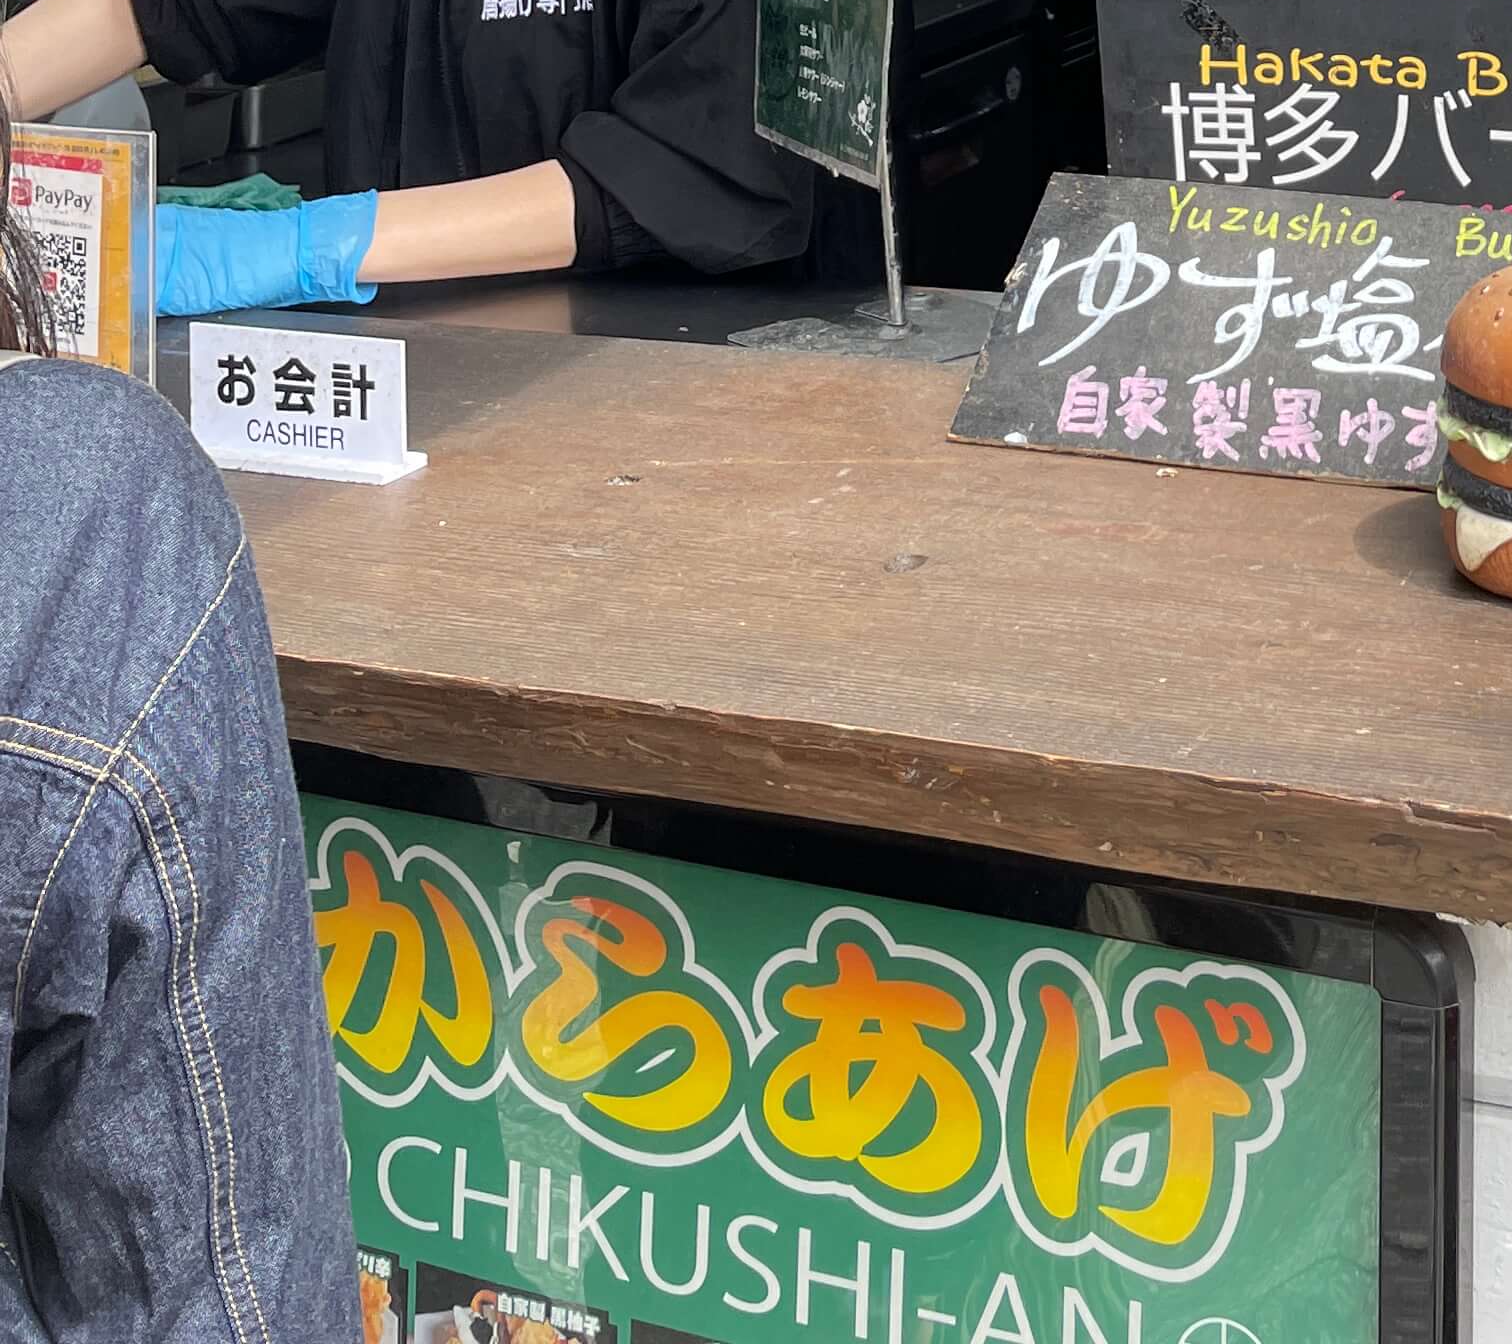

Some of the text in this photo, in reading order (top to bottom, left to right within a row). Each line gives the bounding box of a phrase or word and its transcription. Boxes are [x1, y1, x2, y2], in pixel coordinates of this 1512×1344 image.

[1200, 44, 1427, 90] Hakata
[35, 184, 94, 212] PayPay
[1168, 185, 1378, 249] Yuzushio
[216, 354, 376, 422] お会計
[246, 419, 345, 451] CASHIER
[313, 850, 1274, 1246] からあげ
[377, 1135, 1142, 1344] CHIKUSHI-AN
